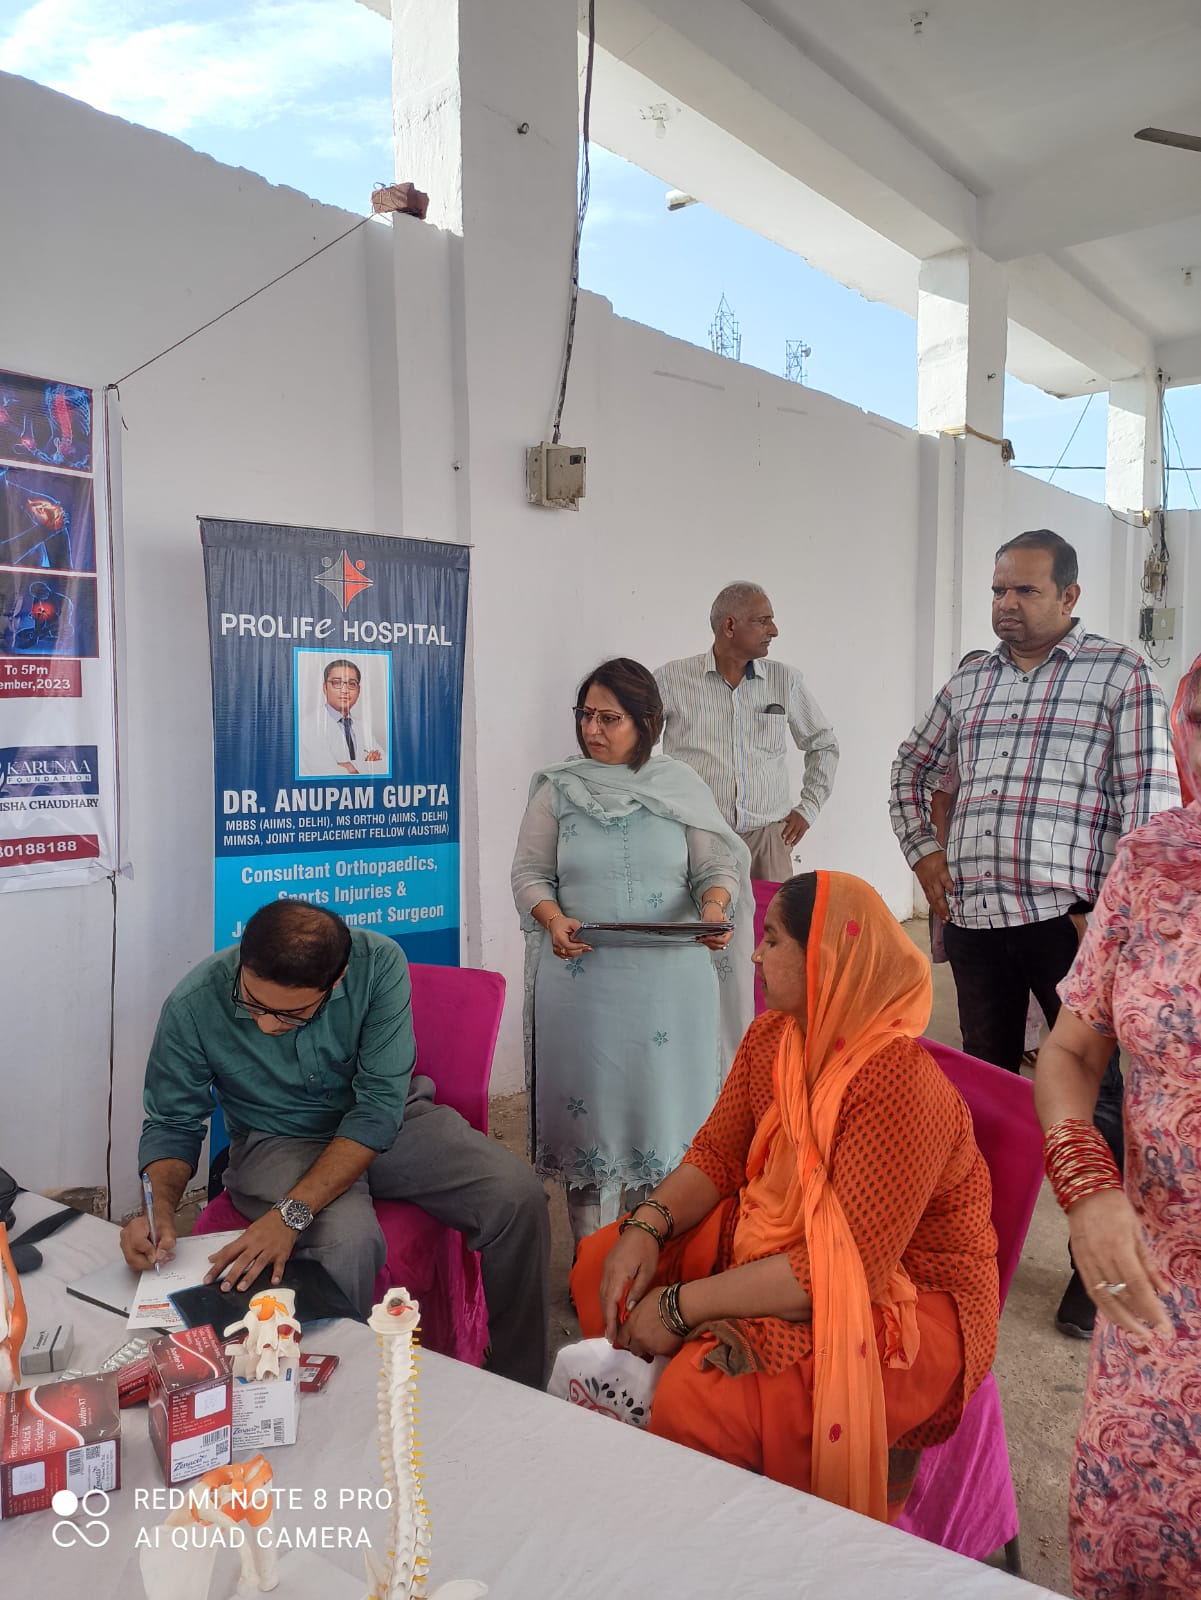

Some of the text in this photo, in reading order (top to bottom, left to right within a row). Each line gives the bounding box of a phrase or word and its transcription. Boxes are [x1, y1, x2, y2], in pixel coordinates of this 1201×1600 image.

[220, 612, 453, 646] PROLIFe HOSPITAL
[4, 664, 49, 676] To 5Pm
[7, 759, 91, 775] KARUNAA
[8, 775, 91, 783] FOUNDATION
[29, 798, 99, 809] CHAUDHARY
[223, 783, 450, 814] DR. ANUPAM GUPTA
[226, 810, 448, 831] MBBS (AIIMS, DELHI), MS ORTHO (AIIMS, DELHI)
[223, 823, 449, 847] MIMSA, JOINT REPLACEMENT FELLOW (AUSTRIA)
[241, 856, 438, 884] Consultant Orthopaedics,
[334, 883, 392, 905] Injuries
[396, 881, 407, 897] &
[387, 904, 445, 923] Surgeon
